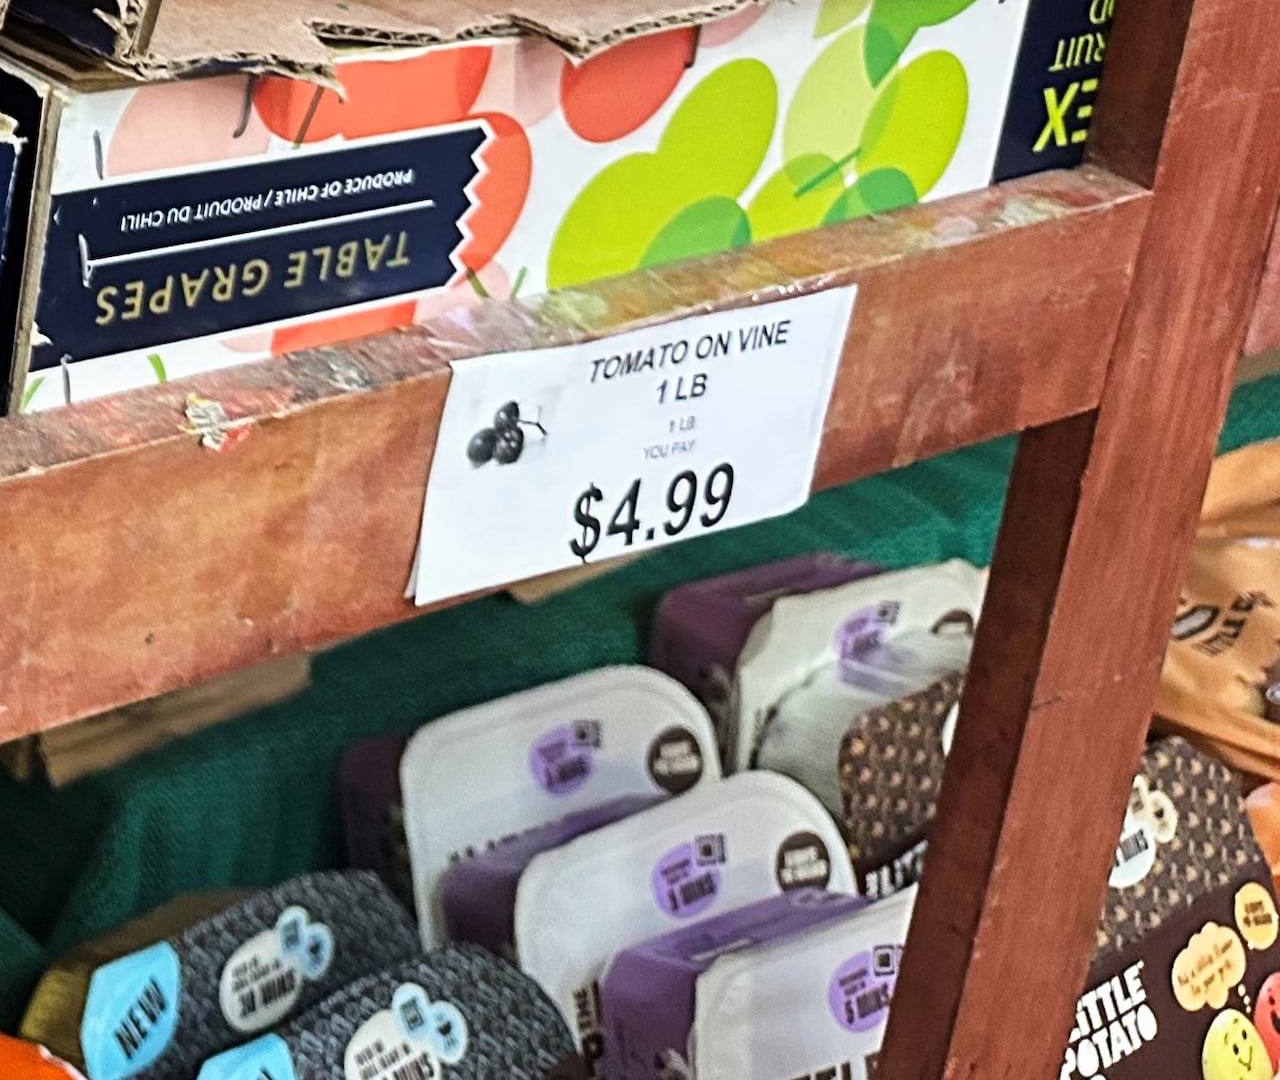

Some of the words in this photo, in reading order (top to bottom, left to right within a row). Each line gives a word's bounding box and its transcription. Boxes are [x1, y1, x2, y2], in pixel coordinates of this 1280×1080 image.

[274, 184, 320, 207] CHILE
[319, 179, 343, 199] OF
[343, 168, 415, 195] PRODUCE
[167, 204, 192, 225] DU
[192, 193, 263, 219] PRODUIT
[120, 210, 165, 232] CHILI
[285, 231, 412, 288] TABLE
[95, 259, 270, 326] GRAPES
[590, 339, 689, 384] TOMATO
[695, 330, 733, 361] ON
[739, 319, 792, 352] VINE
[657, 379, 668, 405] 1
[675, 373, 709, 402] LB
[569, 462, 735, 564] $4.99
[114, 975, 167, 1061] NEW
